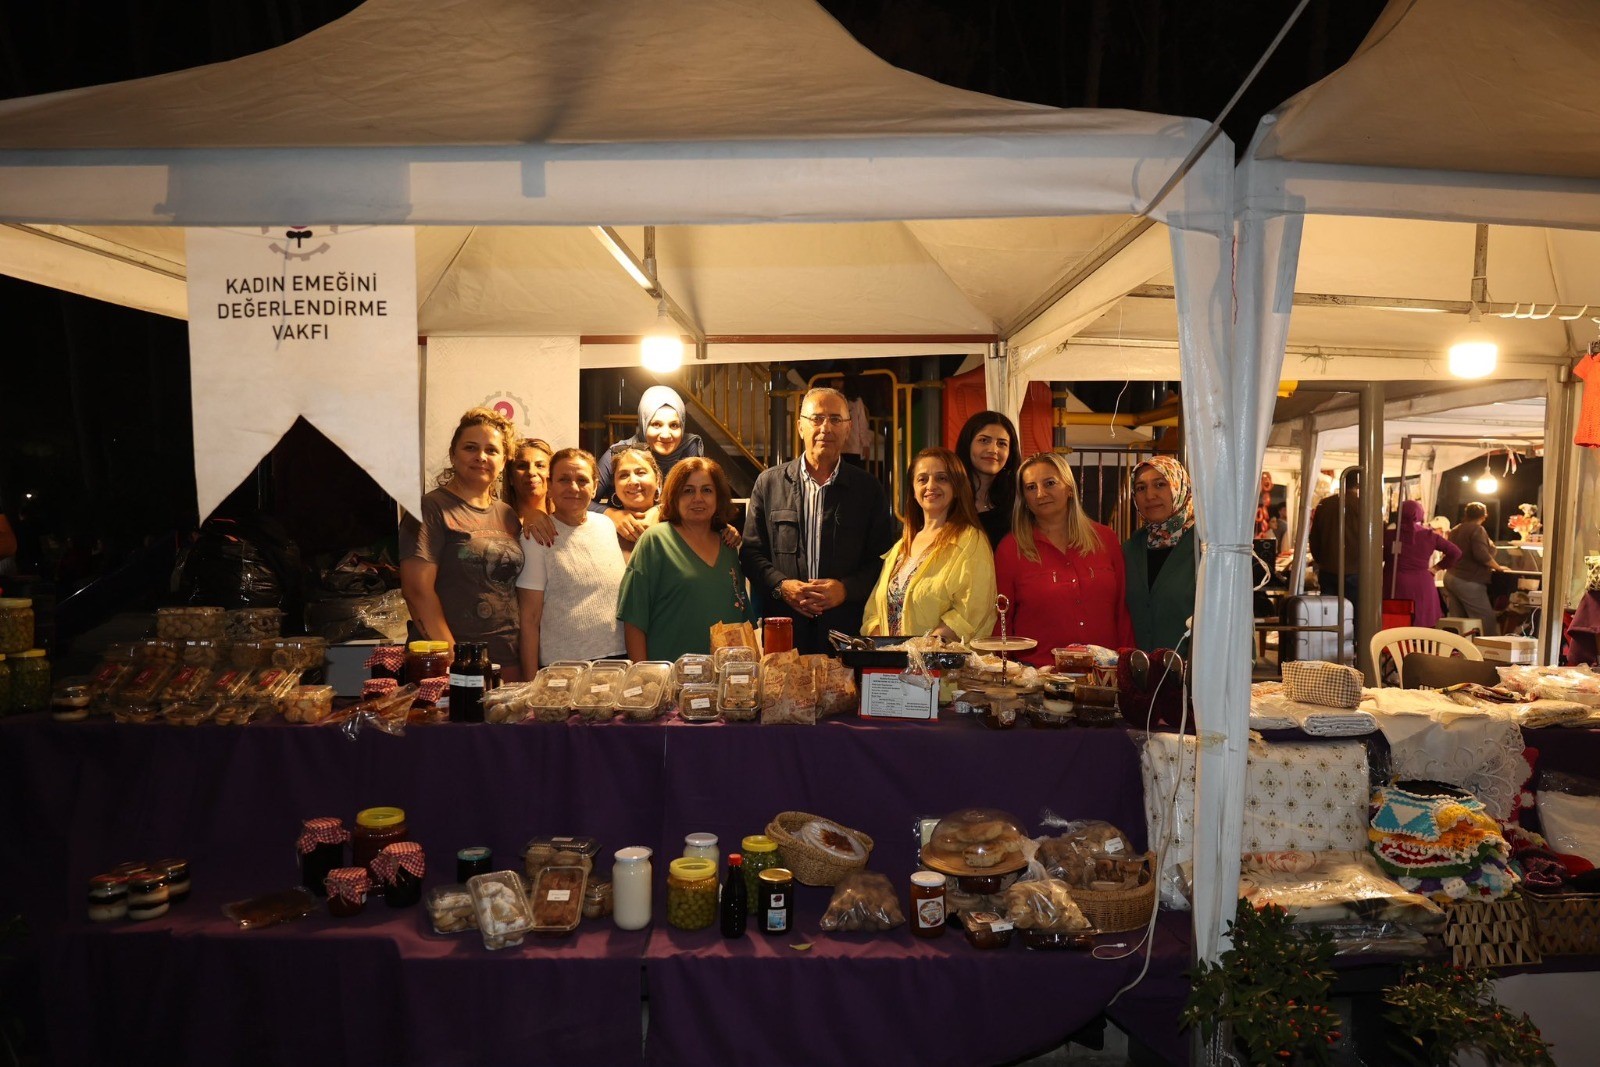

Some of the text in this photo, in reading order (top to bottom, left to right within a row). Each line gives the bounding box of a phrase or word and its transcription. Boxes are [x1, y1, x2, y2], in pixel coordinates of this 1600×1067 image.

[226, 271, 377, 294] KADIN EMEĞİNİ
[217, 297, 388, 319] DEĞERLENDİRME
[272, 324, 328, 341] VAKFI
